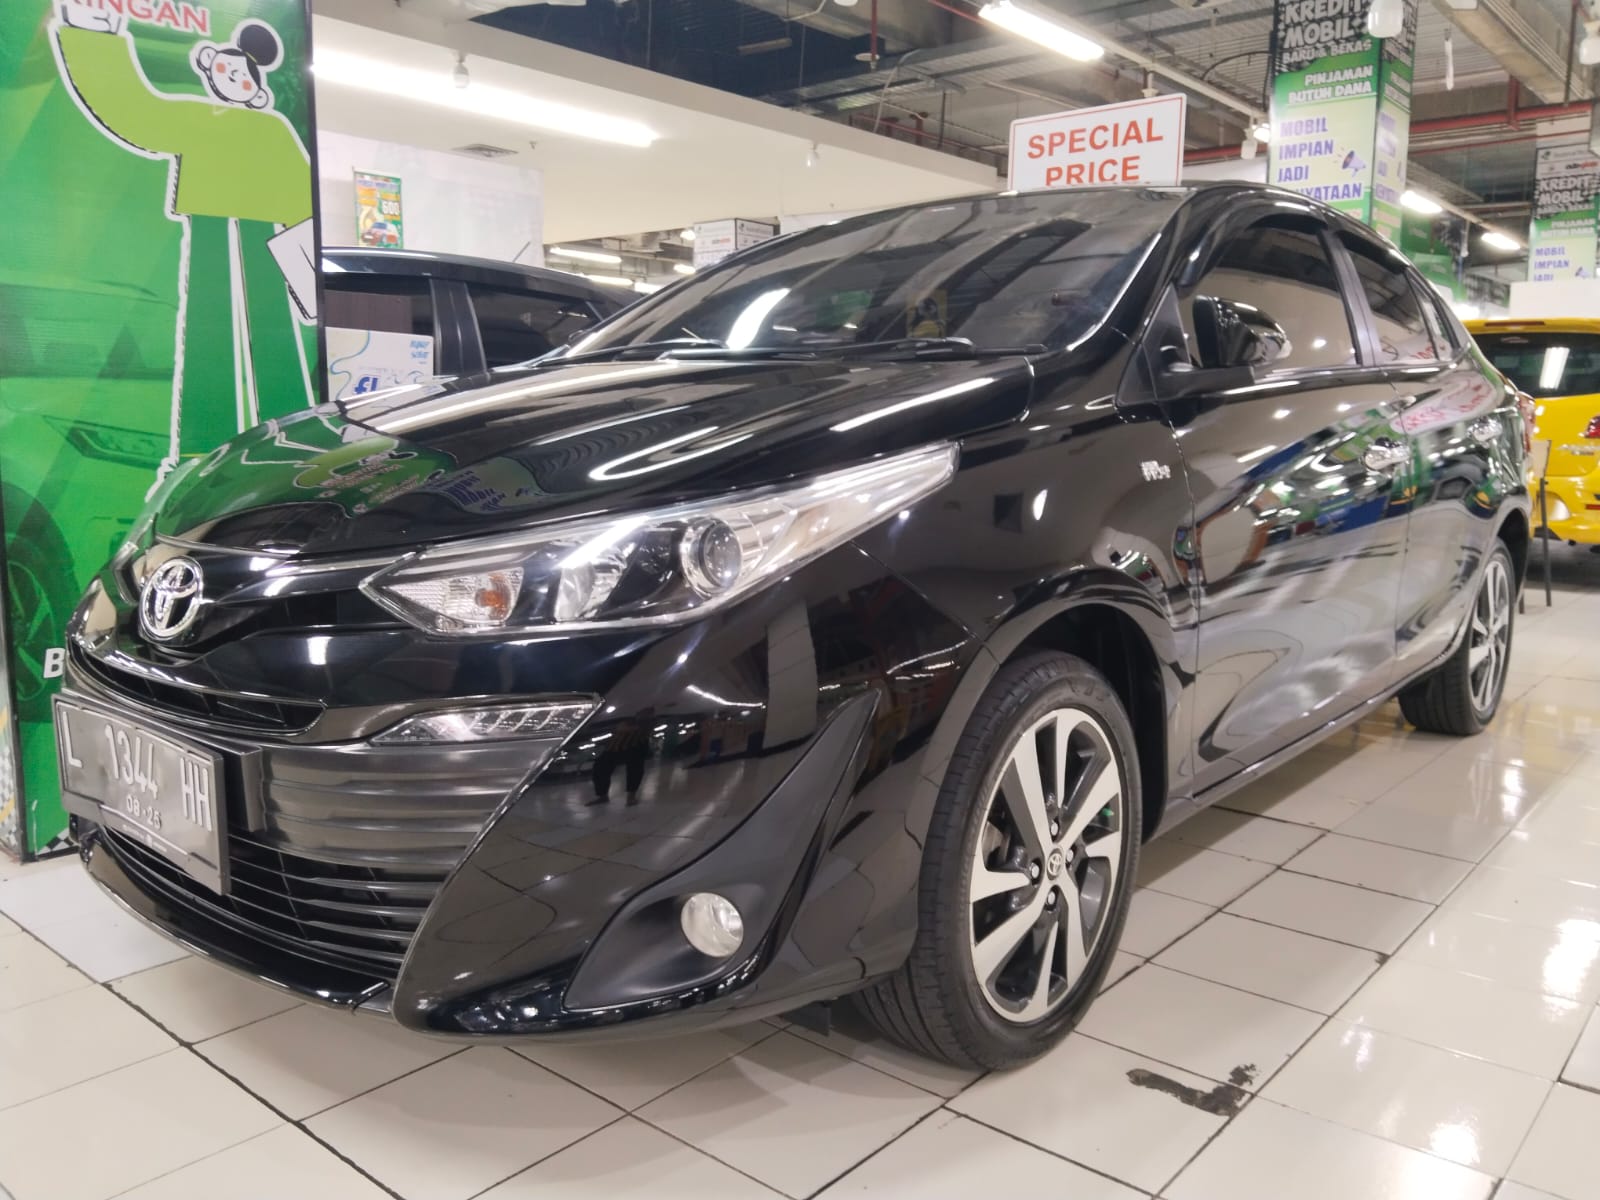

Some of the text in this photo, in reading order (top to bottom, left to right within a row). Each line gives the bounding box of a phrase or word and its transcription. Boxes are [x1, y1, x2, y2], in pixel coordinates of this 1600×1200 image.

[1284, 18, 1354, 49] MOBIL
[1304, 65, 1374, 86] PINJAMAN
[1288, 87, 1332, 105] BUTUH
[1334, 81, 1372, 97] DANA
[1027, 117, 1163, 159] SPECIAL
[1279, 117, 1328, 138] MOBIL
[1279, 140, 1334, 161] IMPIAN
[1045, 155, 1140, 186] PRICE
[1277, 165, 1309, 183] JADI
[62, 711, 213, 833] L 1344 HH
